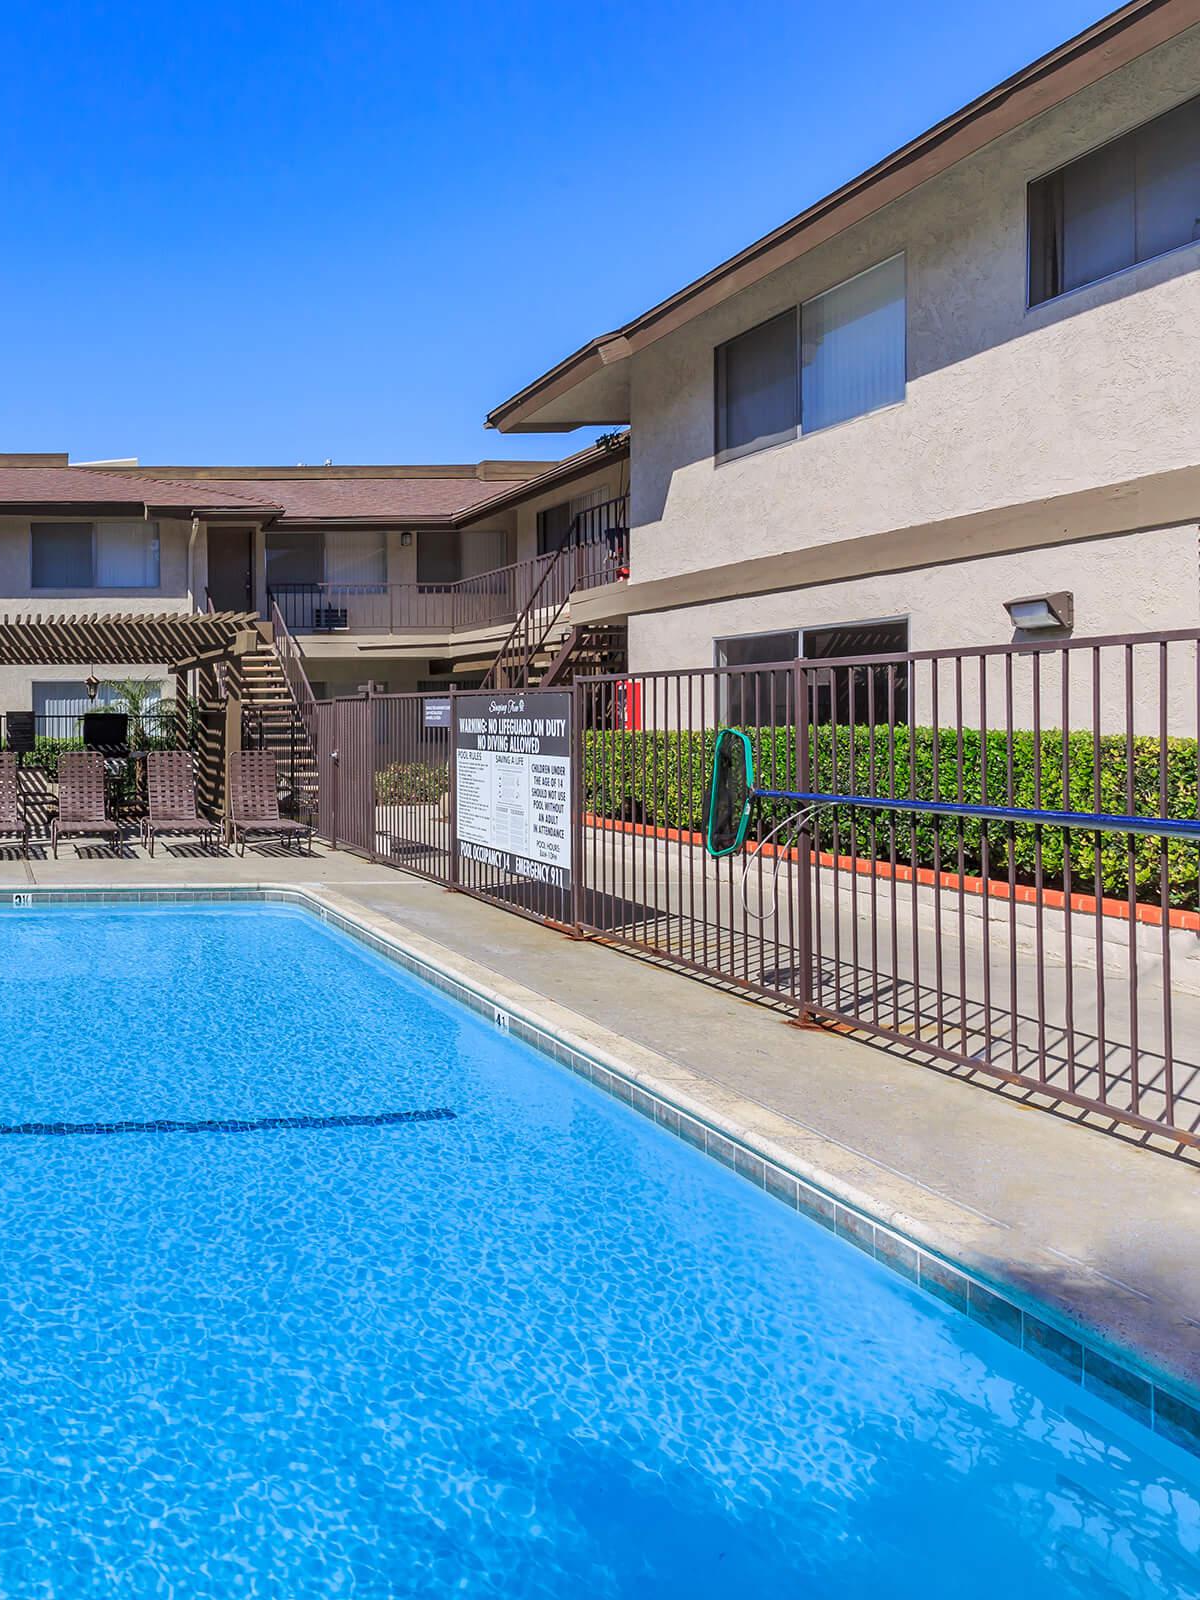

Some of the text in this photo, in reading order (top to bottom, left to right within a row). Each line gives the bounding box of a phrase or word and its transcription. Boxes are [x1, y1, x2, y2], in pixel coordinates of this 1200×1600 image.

[488, 719, 498, 734] NO
[498, 719, 532, 736] LIFEGUARD
[533, 719, 545, 736] ON
[546, 719, 566, 737] DUTY
[477, 734, 540, 754] NO DIVING ALLOWED
[458, 750, 482, 761] POOL RULES
[495, 754, 524, 766] SAVING A LIFE
[531, 763, 566, 776] CHILDREN UNDER
[533, 775, 563, 788] THE AGE OF 14
[531, 788, 566, 802] SHOULD NOT USE
[533, 799, 564, 814] POOL WITHOUT
[538, 813, 558, 825] AN ADULT
[533, 823, 565, 840] IN ATTENDANCE
[459, 841, 473, 859] POOL
[473, 845, 503, 868] OCCUPANCY
[515, 857, 563, 888] EMERGENCY 911
